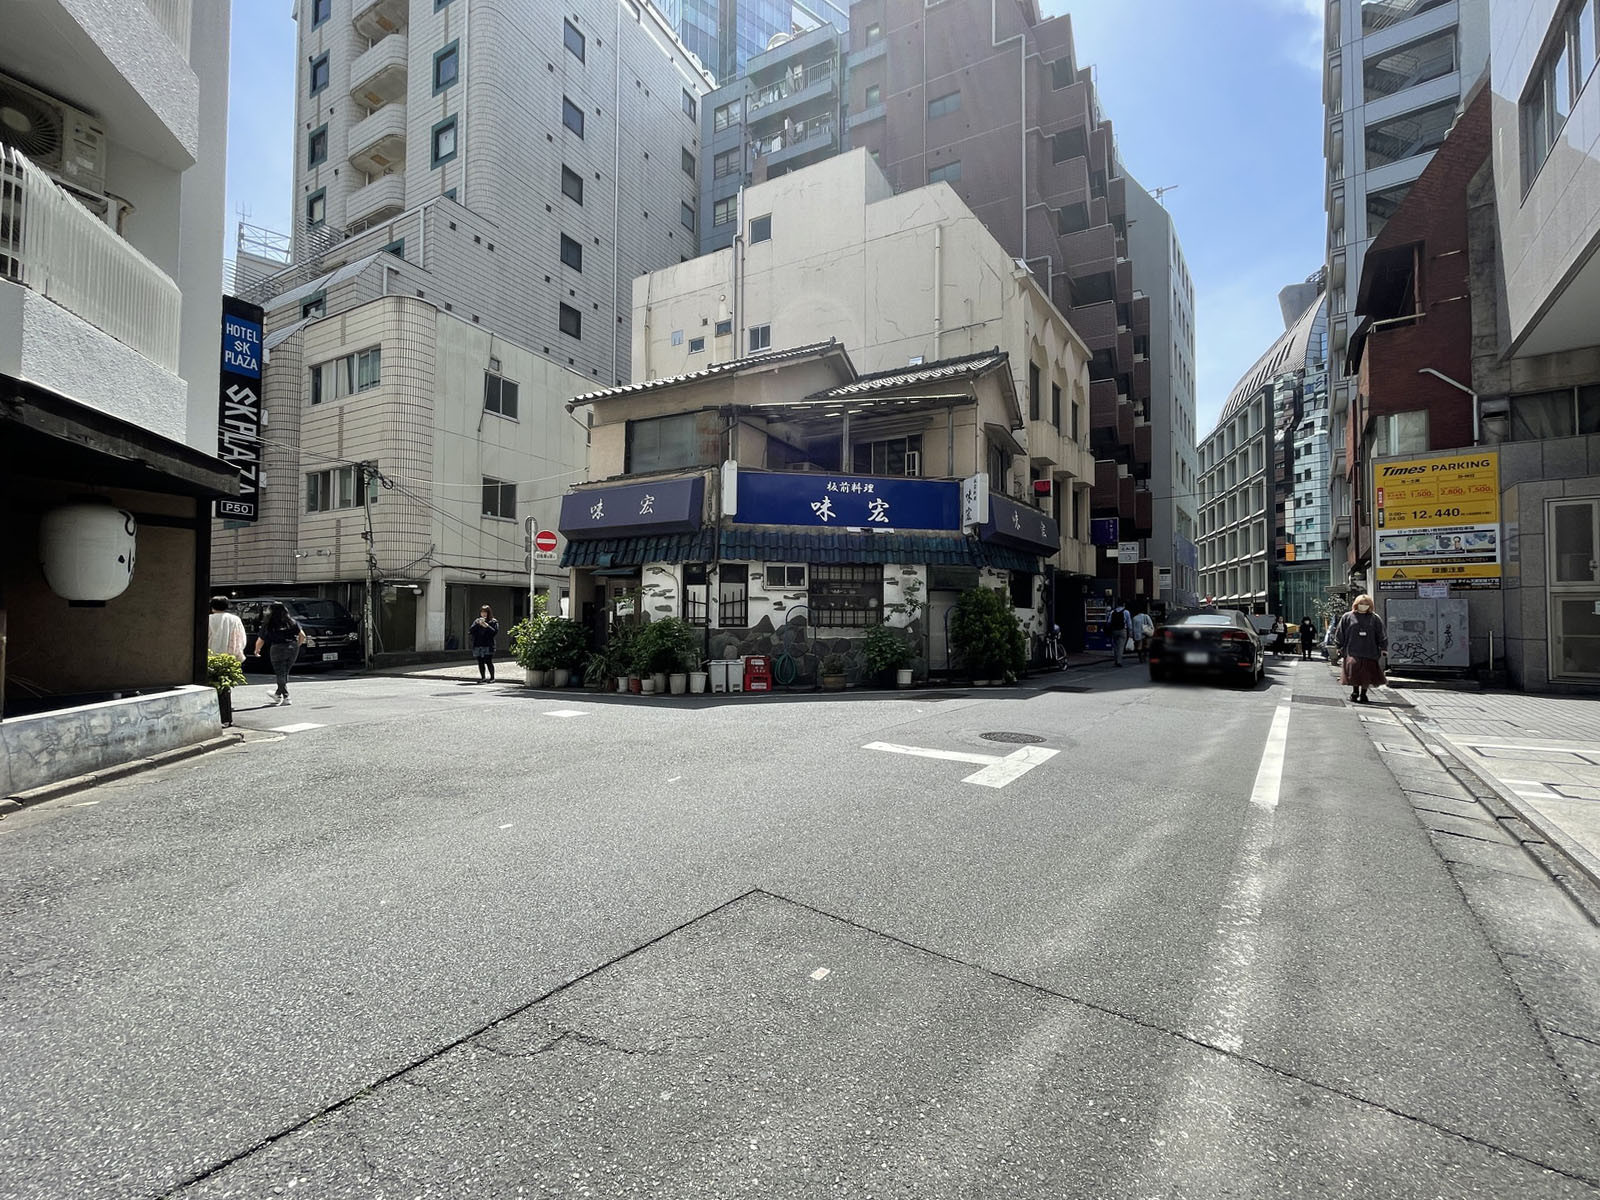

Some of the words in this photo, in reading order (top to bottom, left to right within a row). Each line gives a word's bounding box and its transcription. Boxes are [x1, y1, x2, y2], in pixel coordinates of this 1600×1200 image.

[226, 322, 259, 343] HOTEL
[234, 340, 251, 355] SK
[225, 350, 258, 371] PLAZA
[1382, 465, 1427, 477] Times
[1431, 459, 1490, 472] PARKING
[826, 481, 874, 494] 板前料理
[226, 503, 249, 514] P50
